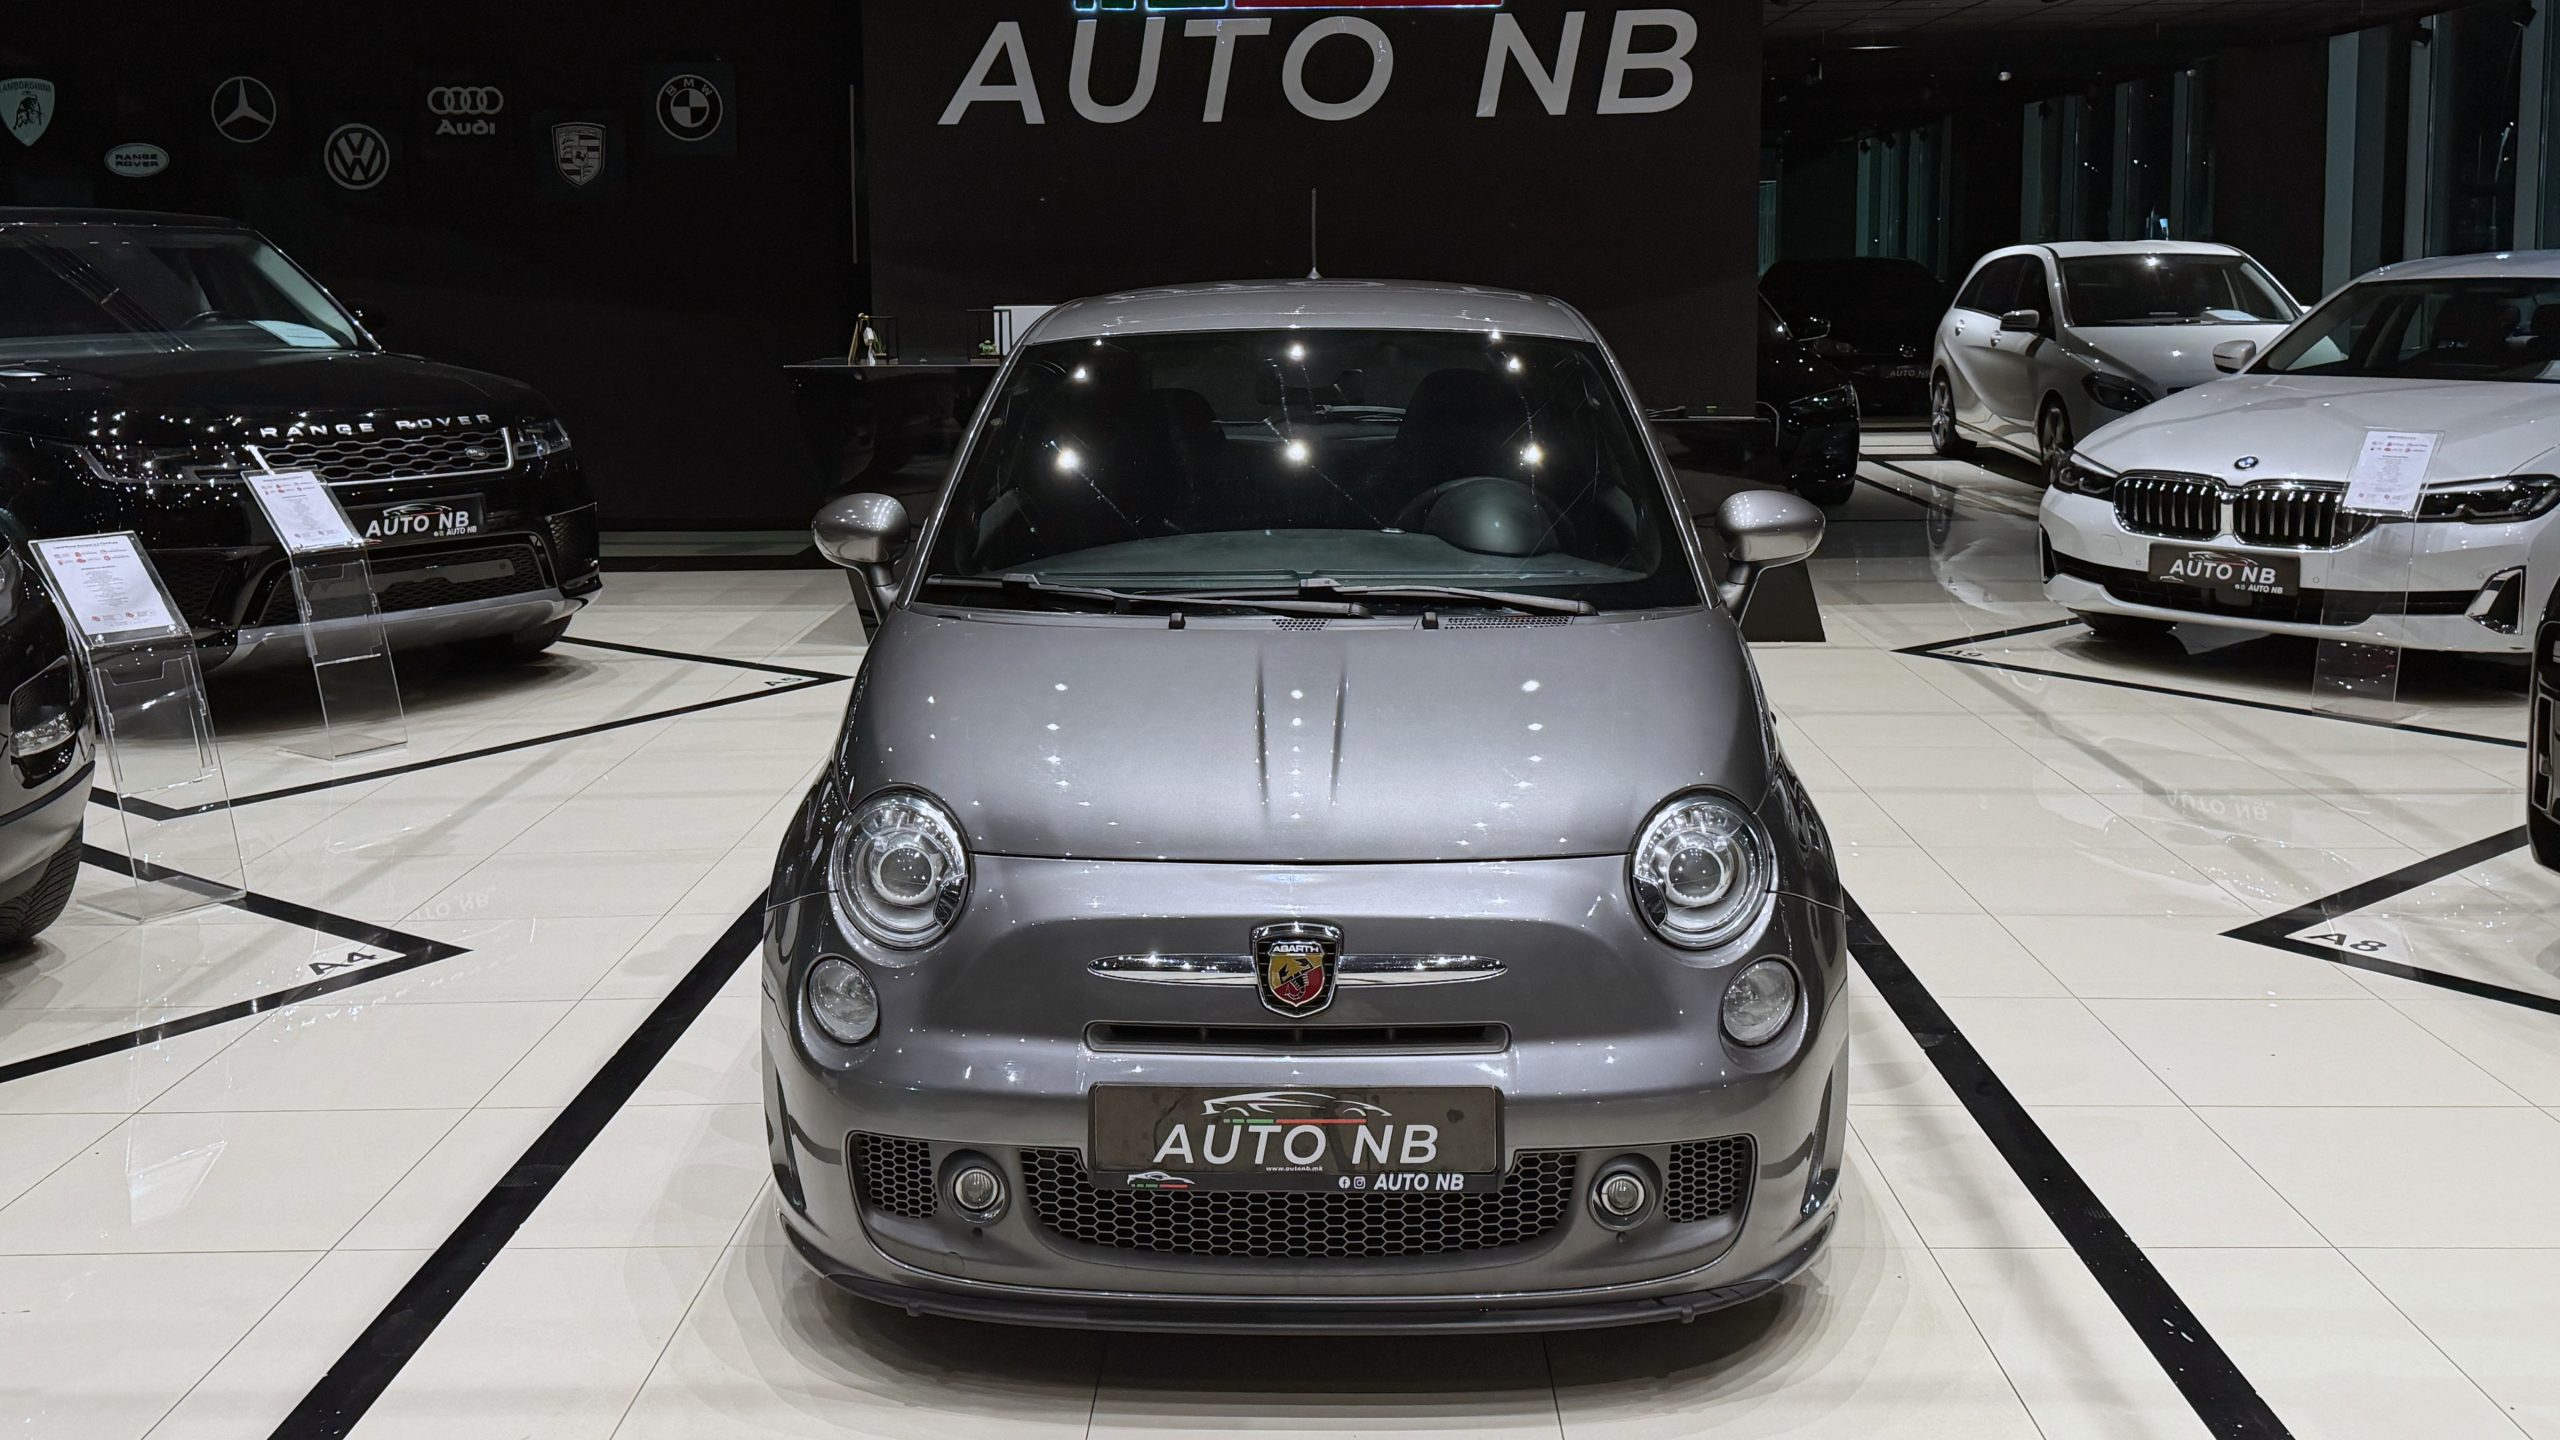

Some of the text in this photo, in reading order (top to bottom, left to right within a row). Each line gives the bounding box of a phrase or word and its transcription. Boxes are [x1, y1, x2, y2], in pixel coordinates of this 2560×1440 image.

[938, 9, 1698, 125] AUTO NB
[665, 78, 713, 97] BMW
[435, 118, 496, 136] Audi
[259, 413, 492, 439] RANGE ROVER
[365, 514, 430, 538] AUTO
[438, 510, 470, 530] NB
[446, 525, 478, 536] AUTO NB
[2169, 558, 2277, 585] AUTO NB
[2247, 583, 2284, 594] AUTO NB
[1273, 945, 1319, 953] ABARTH
[2303, 932, 2388, 952] A8
[308, 951, 378, 976] A4
[1153, 1124, 1438, 1165] AUTO NB
[1373, 1173, 1465, 1192] AUTO NB
